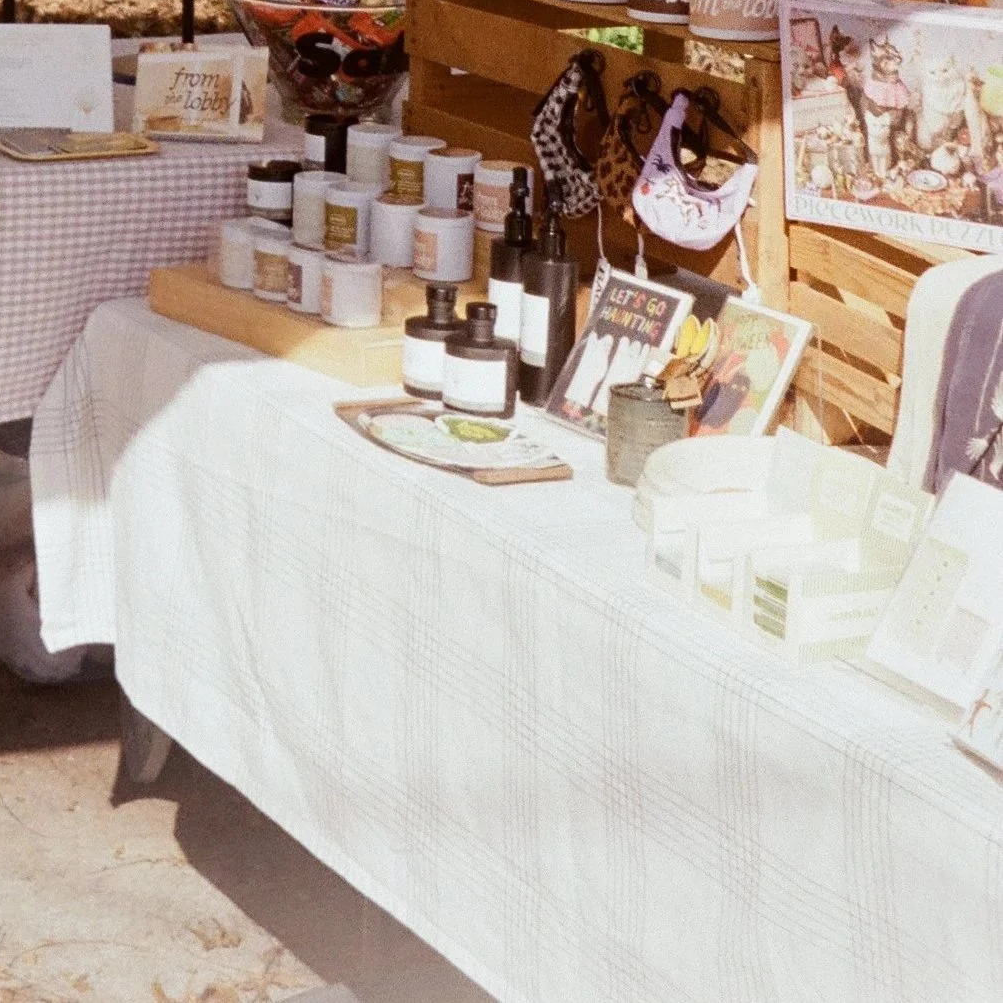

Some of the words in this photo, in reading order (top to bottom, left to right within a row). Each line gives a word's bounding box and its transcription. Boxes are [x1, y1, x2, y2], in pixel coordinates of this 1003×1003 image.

[169, 67, 220, 90] from
[184, 90, 237, 115] lobby
[930, 219, 1003, 249] PUZZL
[609, 286, 648, 309] LET'S
[646, 297, 668, 317] GO
[599, 304, 663, 340] HAUNTING
